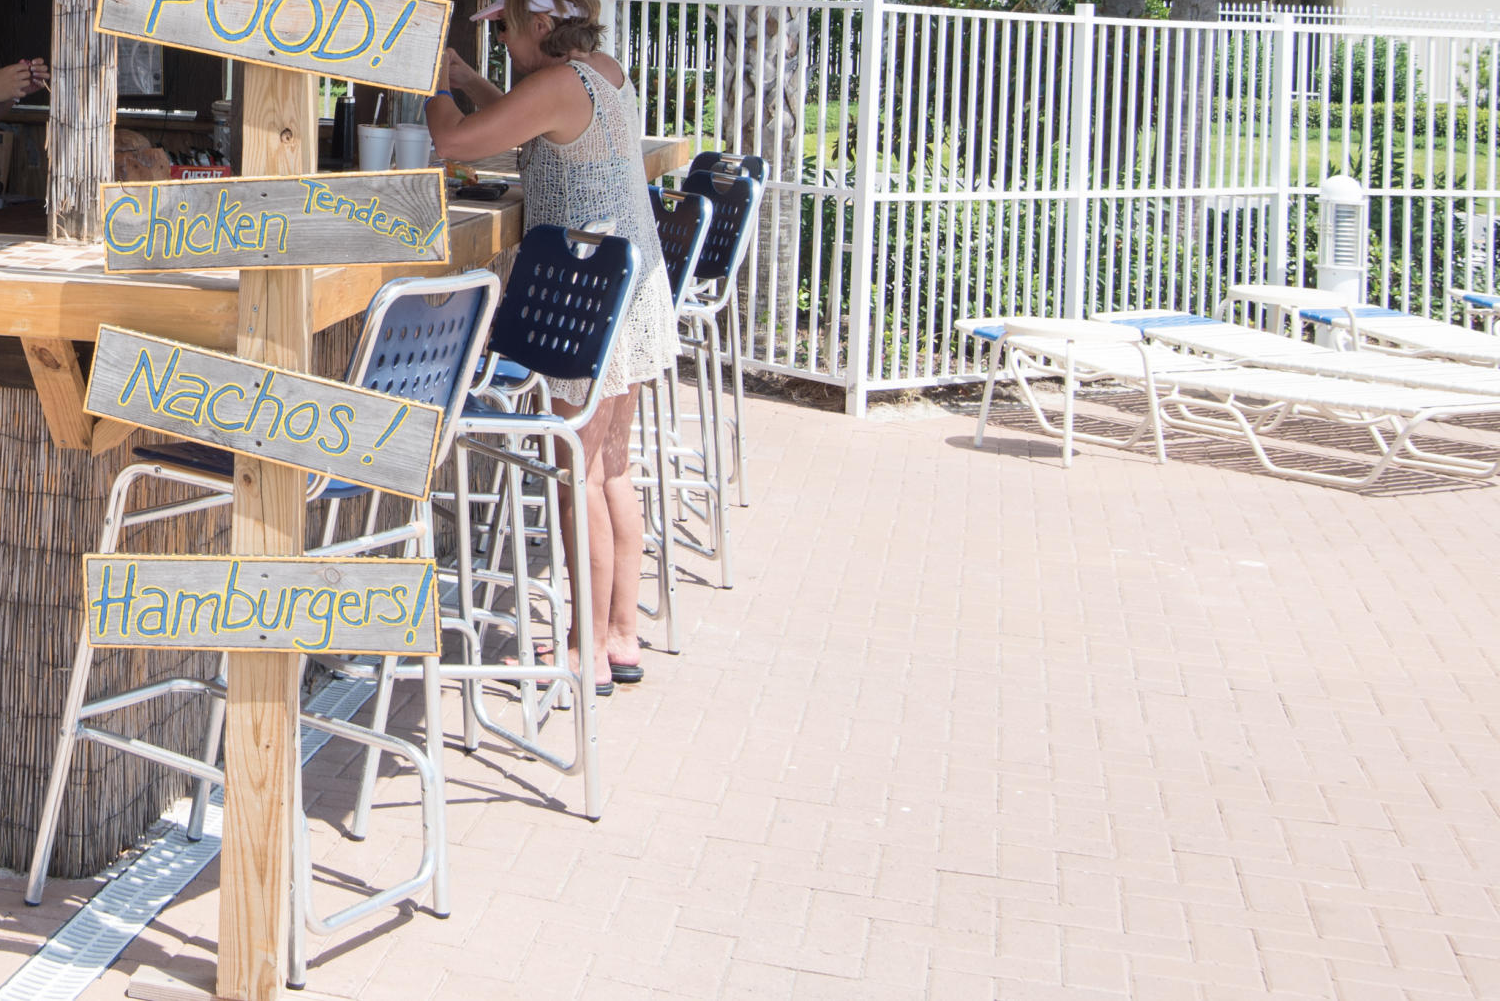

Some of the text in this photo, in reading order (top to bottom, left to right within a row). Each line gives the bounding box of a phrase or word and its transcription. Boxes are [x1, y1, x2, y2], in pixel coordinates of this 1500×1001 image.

[103, 177, 446, 260] Chicken Tenders!
[120, 345, 410, 466] Nachos!
[91, 559, 434, 651] Hamburgers!
